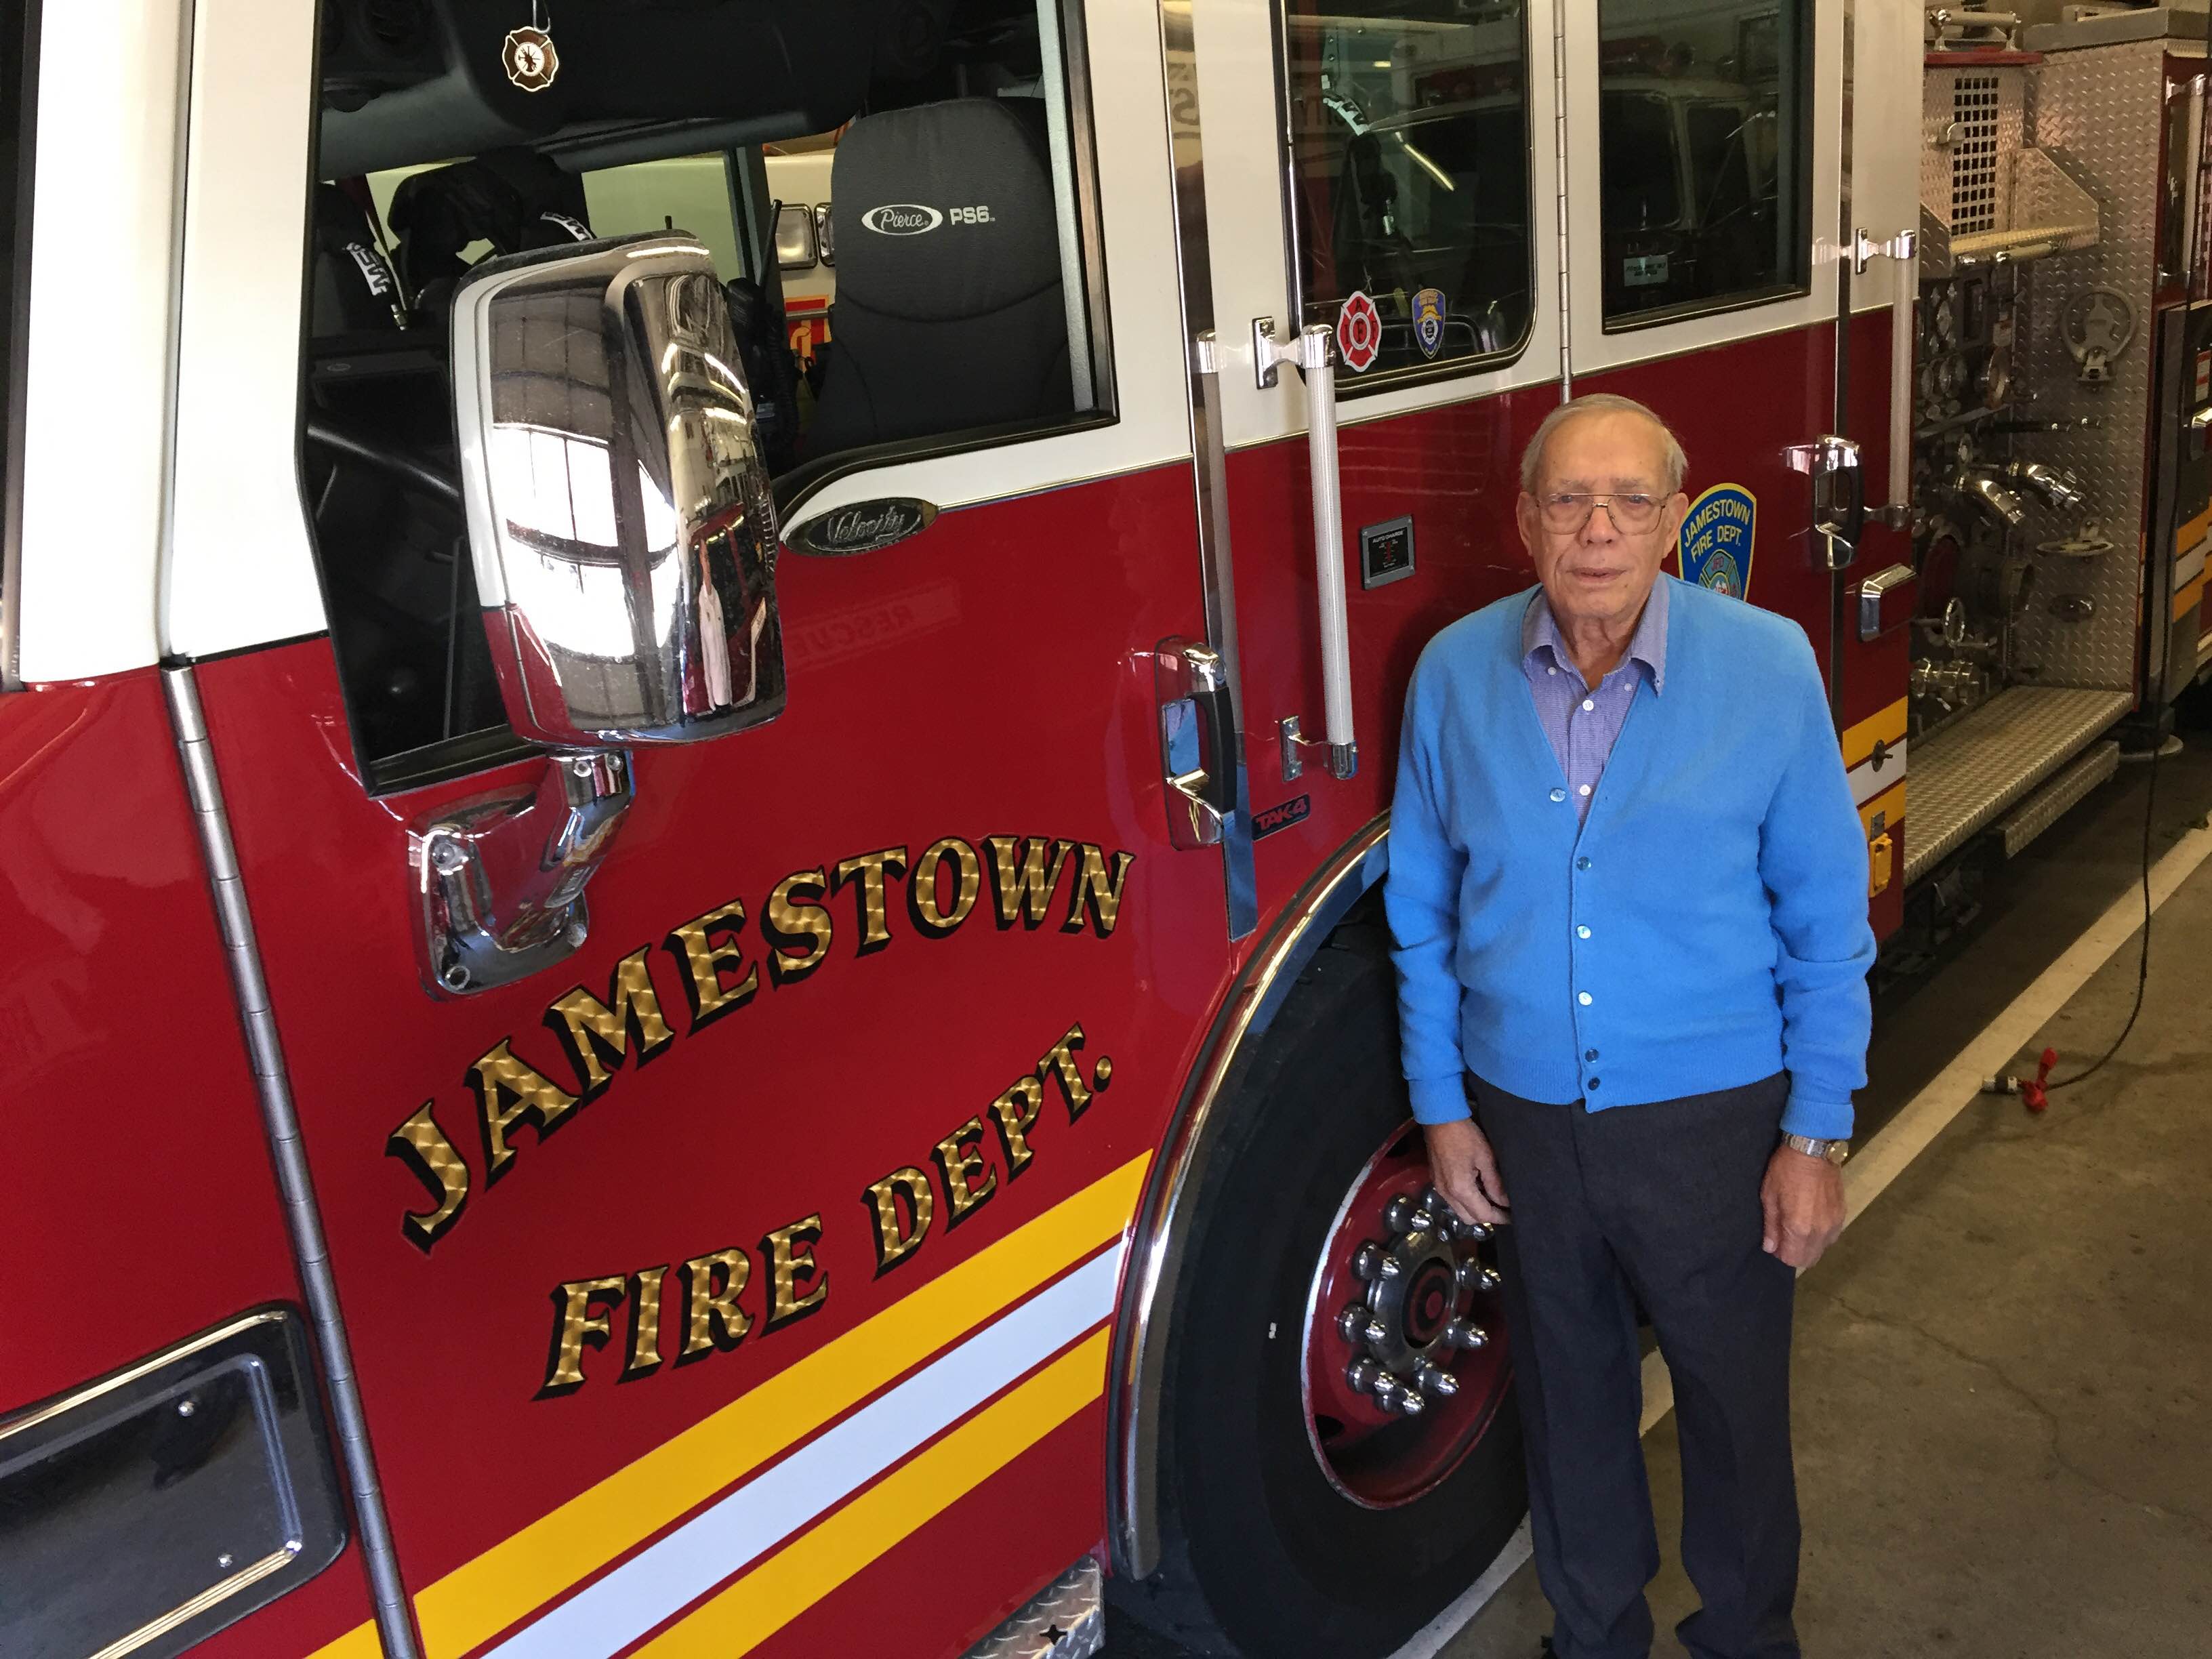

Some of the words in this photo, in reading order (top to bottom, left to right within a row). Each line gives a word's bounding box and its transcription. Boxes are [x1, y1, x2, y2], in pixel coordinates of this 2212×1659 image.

[880, 208, 924, 230] Pierce
[827, 506, 906, 544] Velocity
[1684, 499, 1750, 548] JAMESTOWN
[1691, 530, 1713, 563] FIRE
[386, 835, 1134, 1254] JAMESTOWN
[531, 1212, 828, 1401] FIRE
[860, 1022, 1113, 1280] DEPT.
